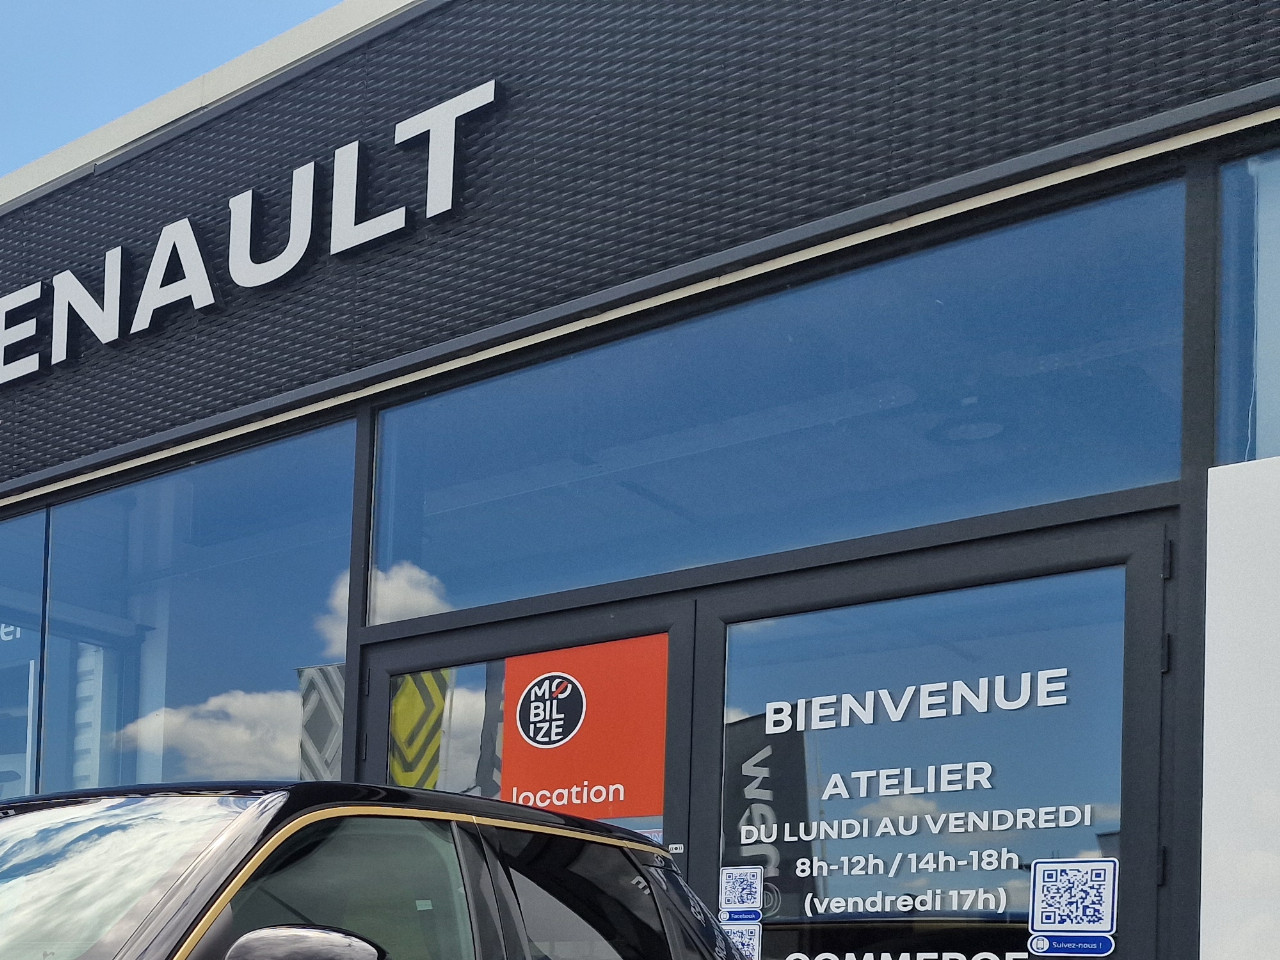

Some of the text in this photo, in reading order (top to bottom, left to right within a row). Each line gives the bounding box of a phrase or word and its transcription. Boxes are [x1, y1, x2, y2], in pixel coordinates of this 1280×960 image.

[529, 699, 565, 723] BIL
[765, 667, 1068, 735] BIENVENUE
[529, 720, 564, 742] IZE
[512, 780, 625, 808] location
[821, 760, 993, 801] ATELIER
[740, 804, 1092, 845] DU LUNDI AU VENDREDI
[804, 887, 1007, 917] (vendredi 17h)
[1052, 941, 1097, 949] Suivez-nous
